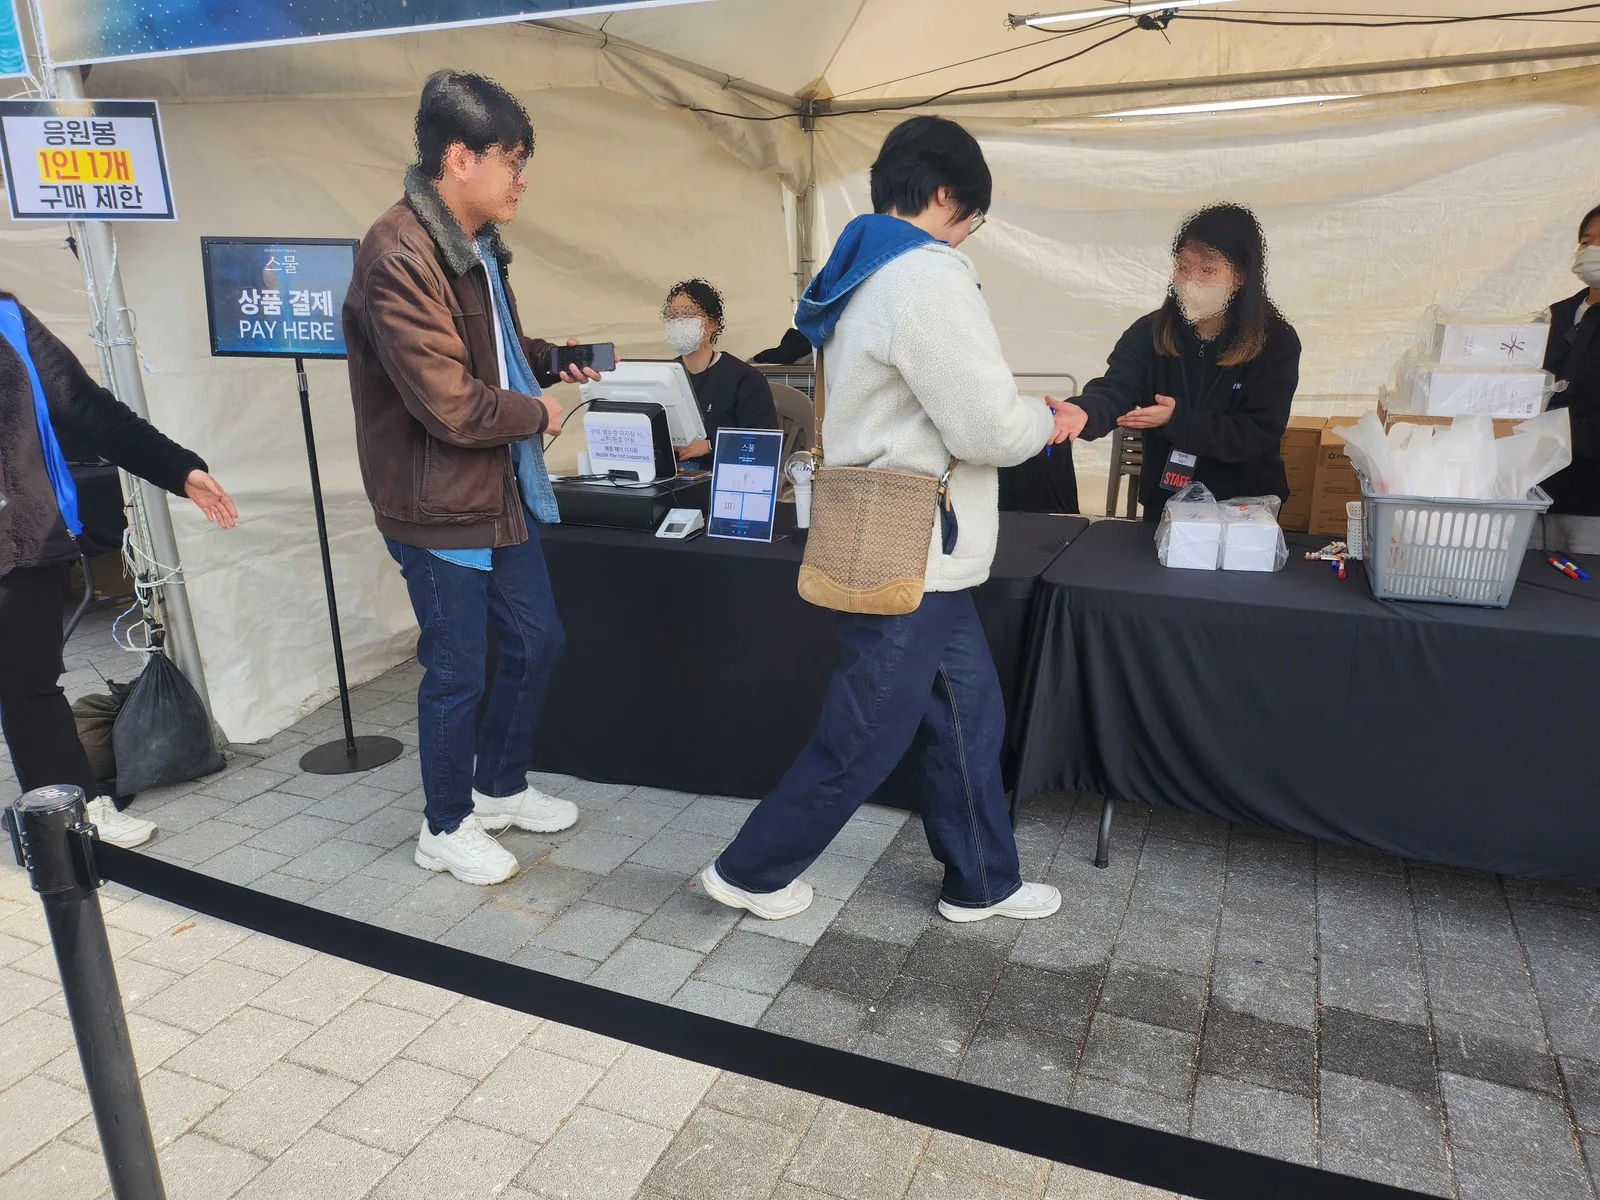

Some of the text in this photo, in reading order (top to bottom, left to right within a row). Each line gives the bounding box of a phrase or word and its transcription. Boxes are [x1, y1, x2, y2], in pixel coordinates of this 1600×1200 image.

[43, 120, 117, 146] 응원봉
[39, 150, 130, 181] 1인 1개
[39, 184, 143, 210] 구매 제한
[265, 255, 299, 274] 스물
[238, 288, 334, 317] 상품 결제
[239, 320, 336, 341] PAY HERE
[595, 451, 609, 459] Apple
[1163, 471, 1191, 489] STAFF
